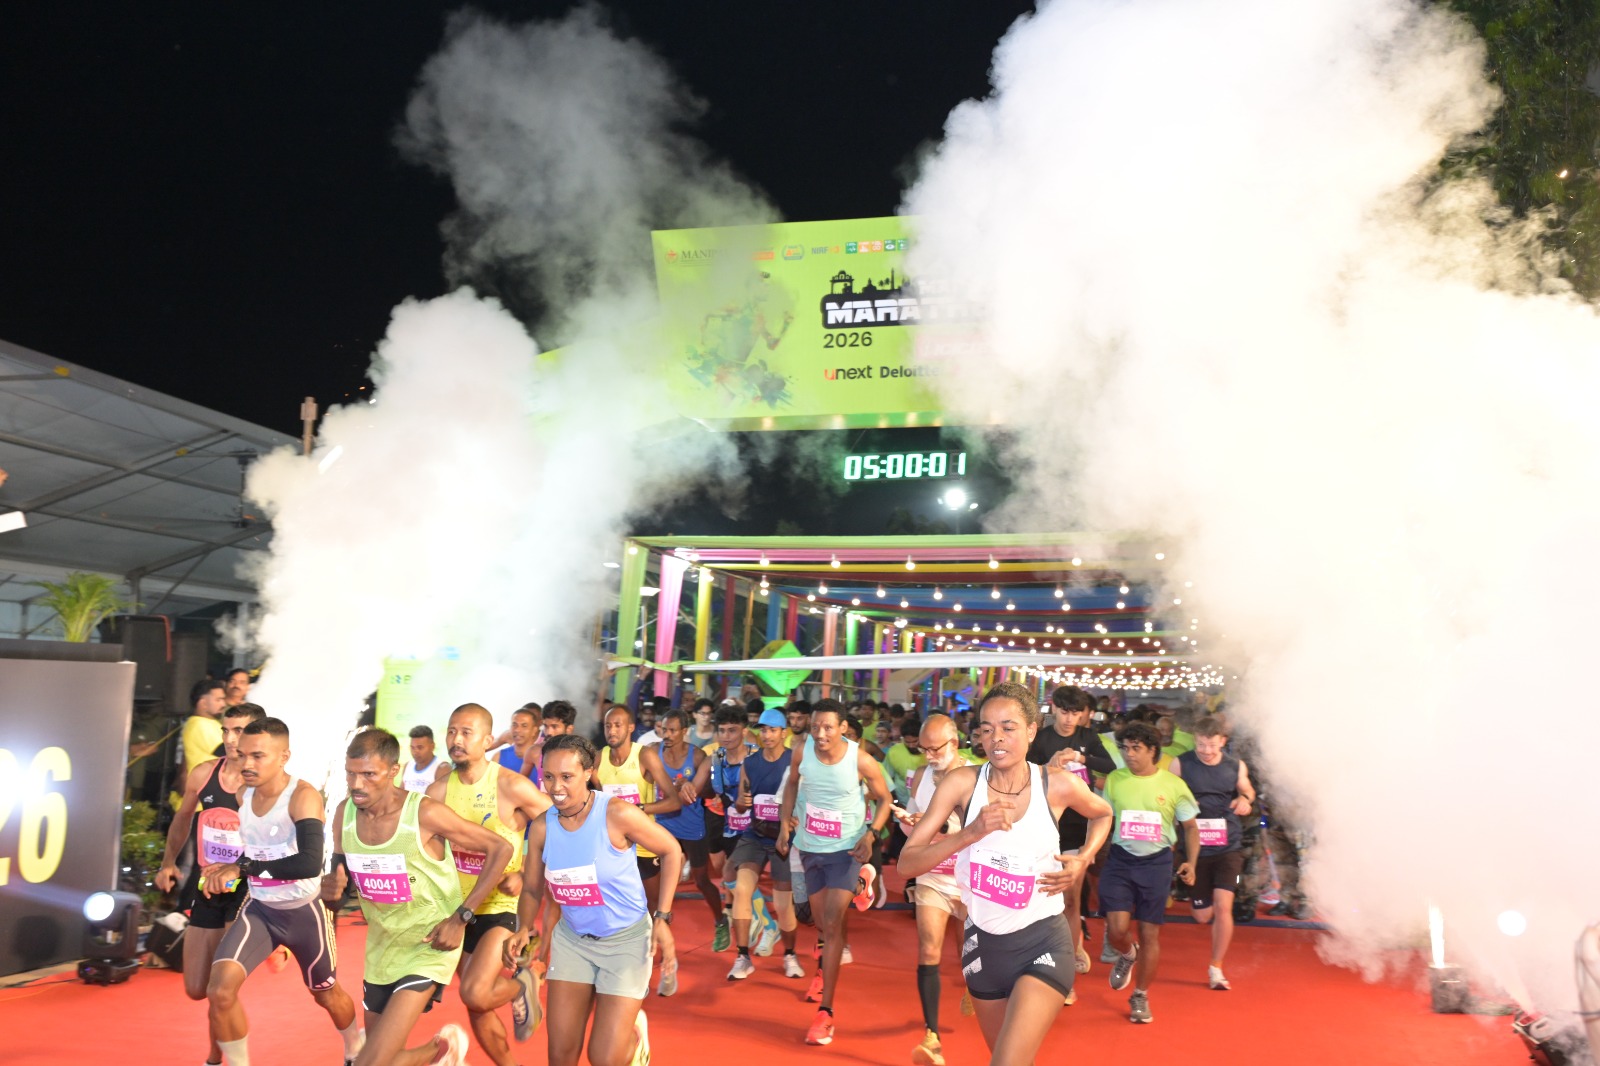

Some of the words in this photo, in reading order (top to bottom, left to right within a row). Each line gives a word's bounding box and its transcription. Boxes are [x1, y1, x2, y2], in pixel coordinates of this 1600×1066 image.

[823, 332, 873, 348] 2026
[824, 365, 873, 381] unext
[843, 452, 967, 480] 05:00:01
[811, 821, 835, 831] 40013
[1130, 825, 1155, 834] 43012
[211, 846, 239, 858] 23054
[363, 878, 398, 890] 40041
[986, 873, 1025, 894] 40505
[557, 888, 592, 898] 40502
